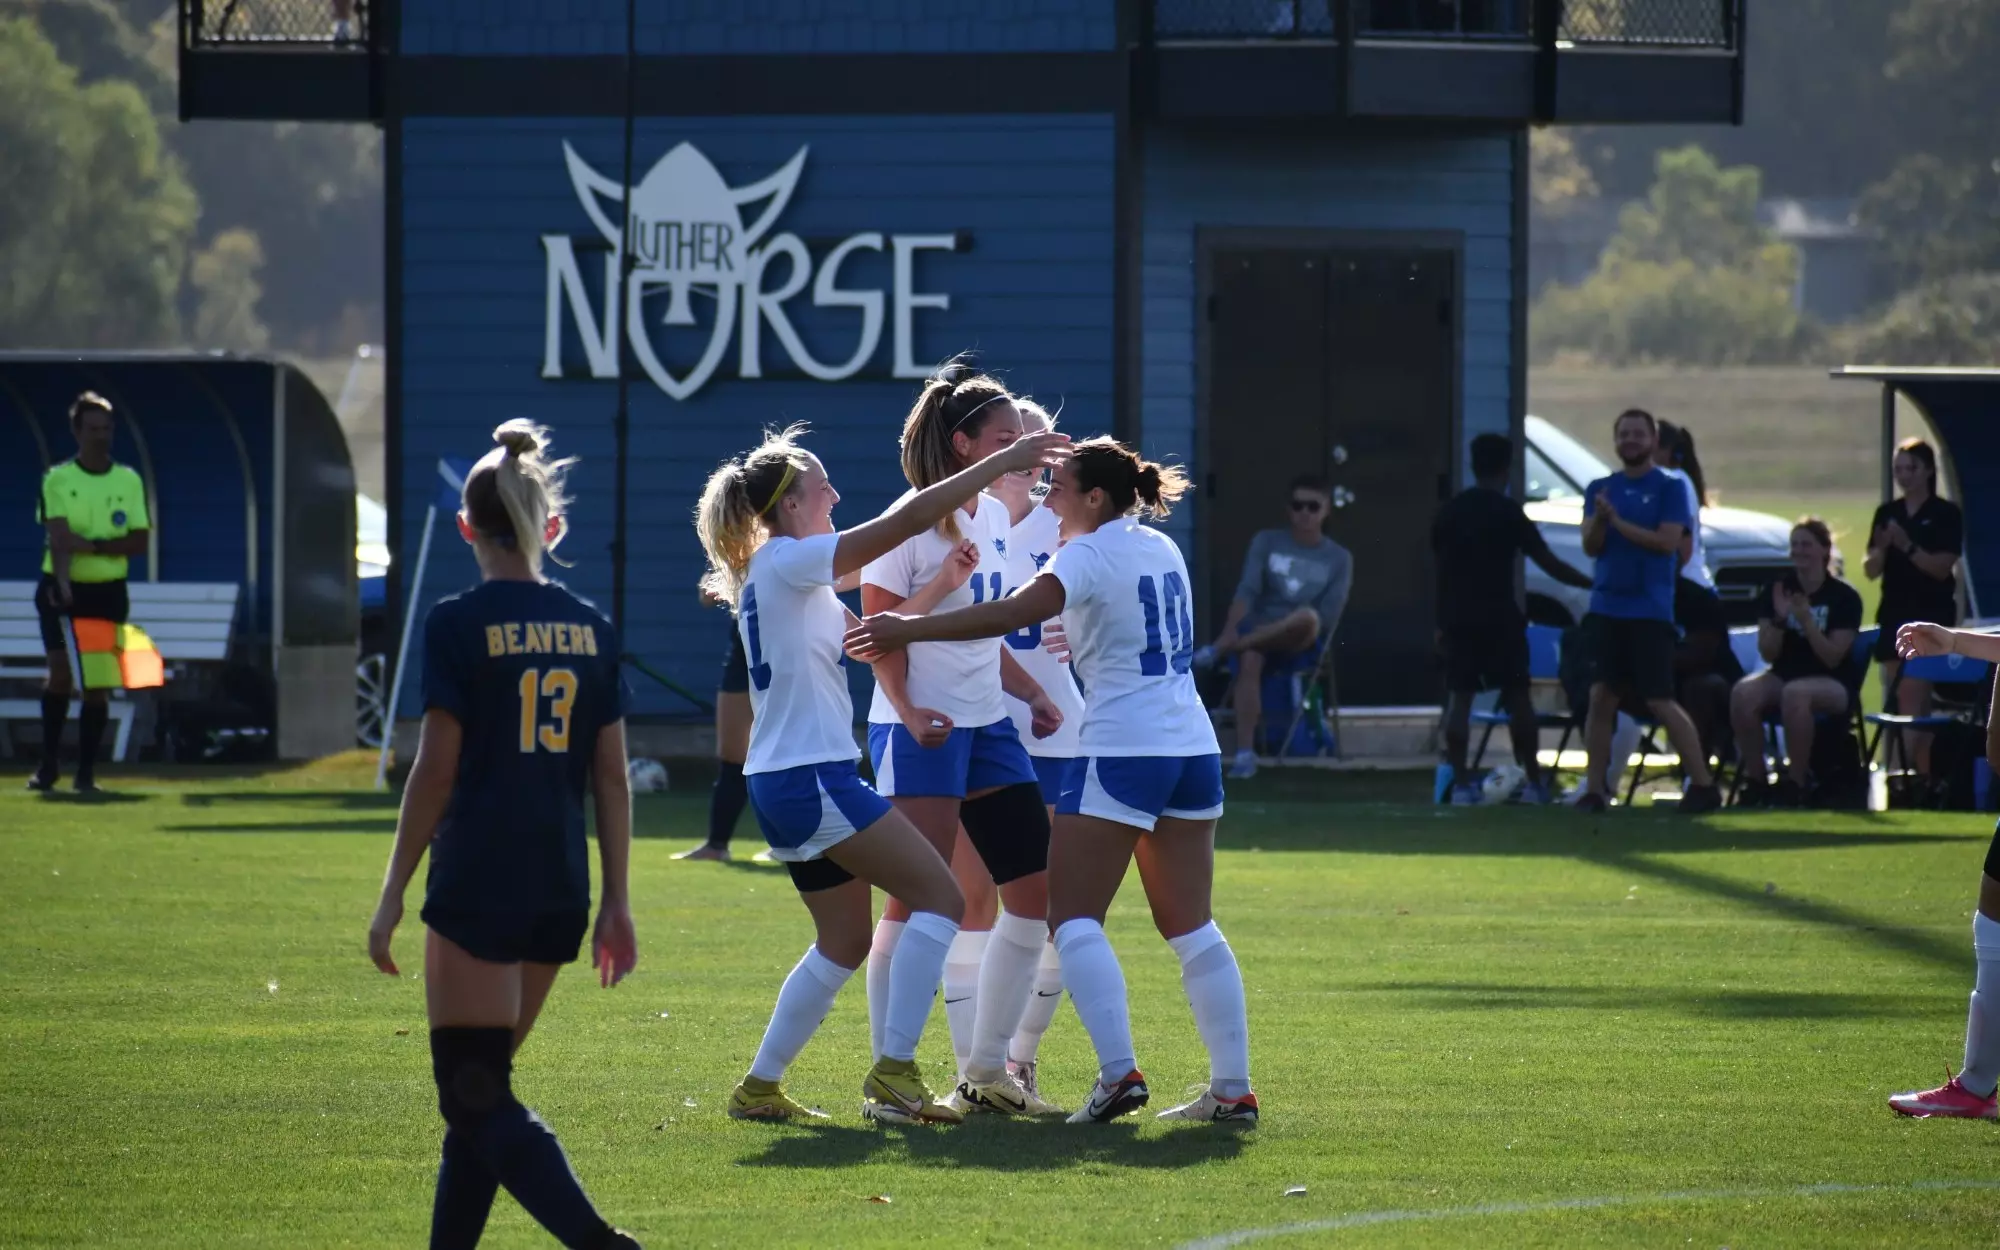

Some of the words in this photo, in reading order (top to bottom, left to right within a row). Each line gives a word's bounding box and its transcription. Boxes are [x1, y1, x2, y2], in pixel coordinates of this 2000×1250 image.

[630, 213, 735, 272] LUTHER
[541, 231, 956, 401] NORSE
[1138, 570, 1193, 676] 10
[518, 667, 579, 753] 13
